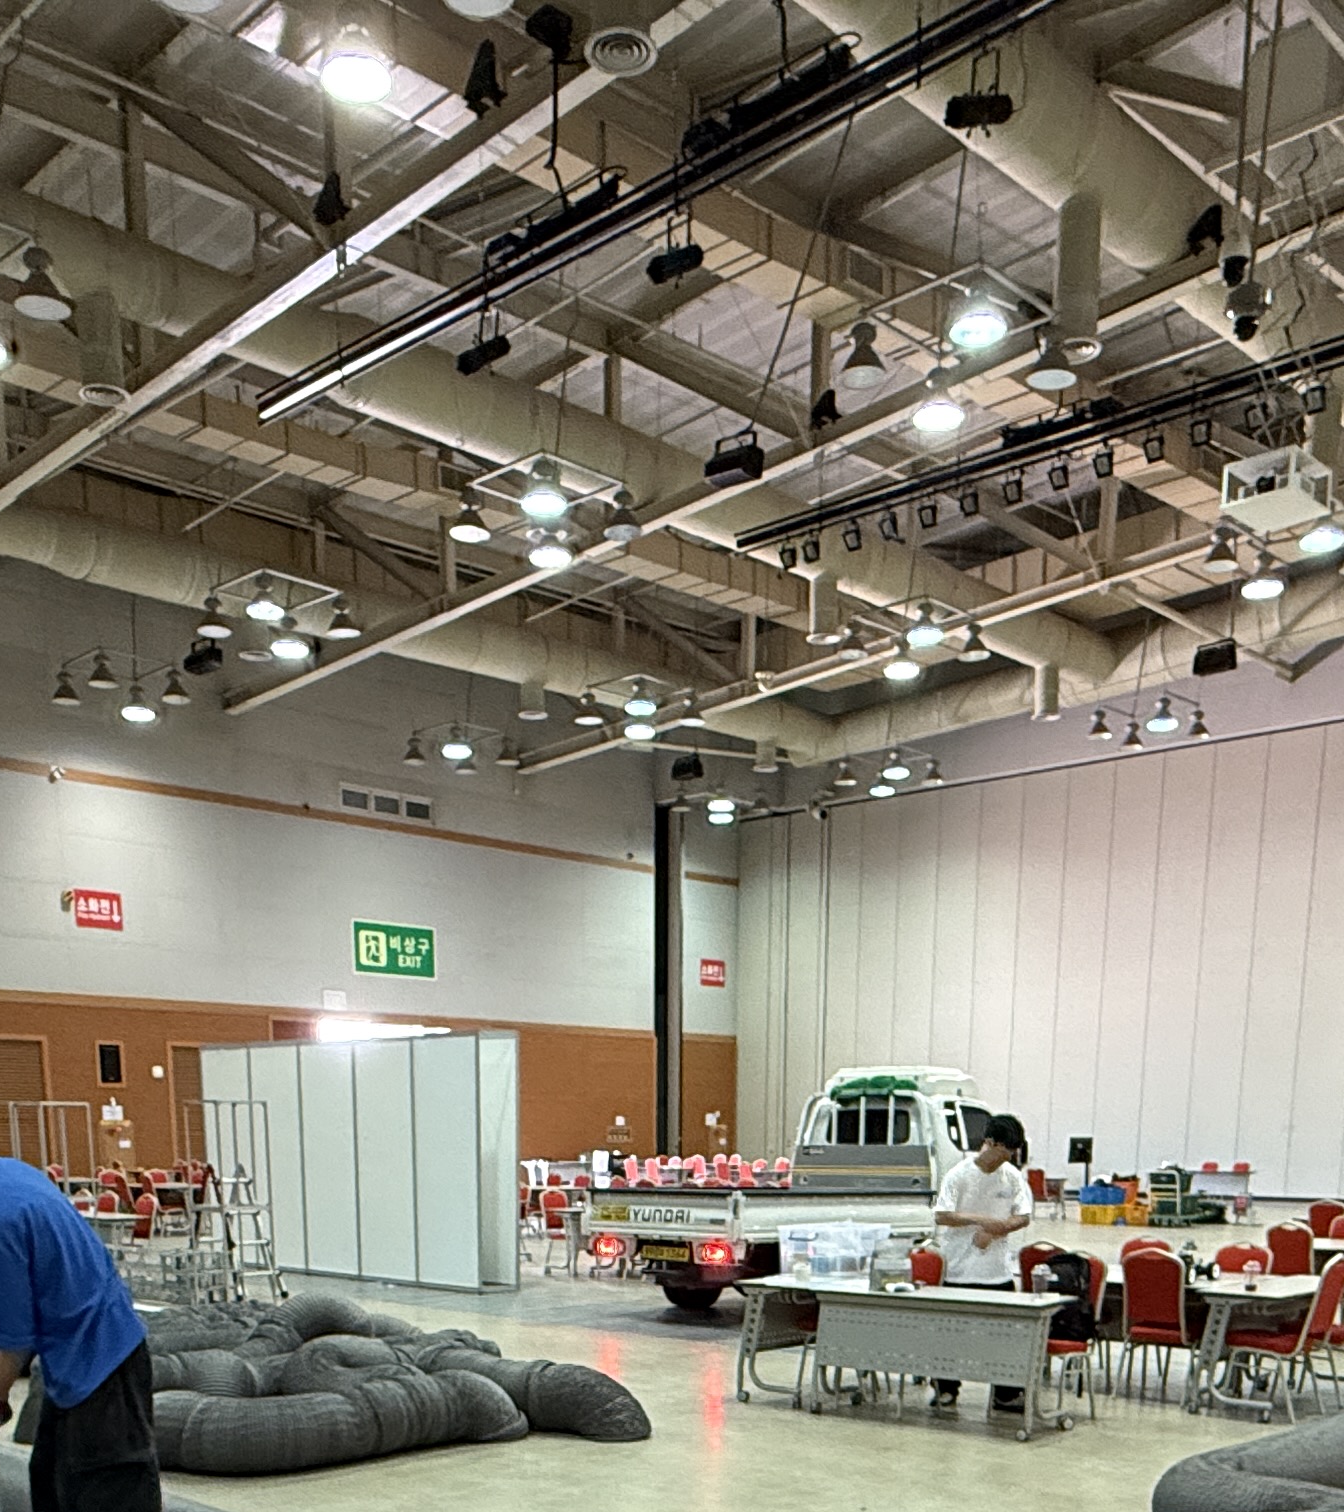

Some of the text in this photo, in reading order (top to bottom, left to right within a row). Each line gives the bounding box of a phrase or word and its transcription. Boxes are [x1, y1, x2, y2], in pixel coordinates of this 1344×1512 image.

[77, 896, 111, 915] 소화전
[389, 935, 431, 956] 비상구
[398, 954, 423, 969] EXIT
